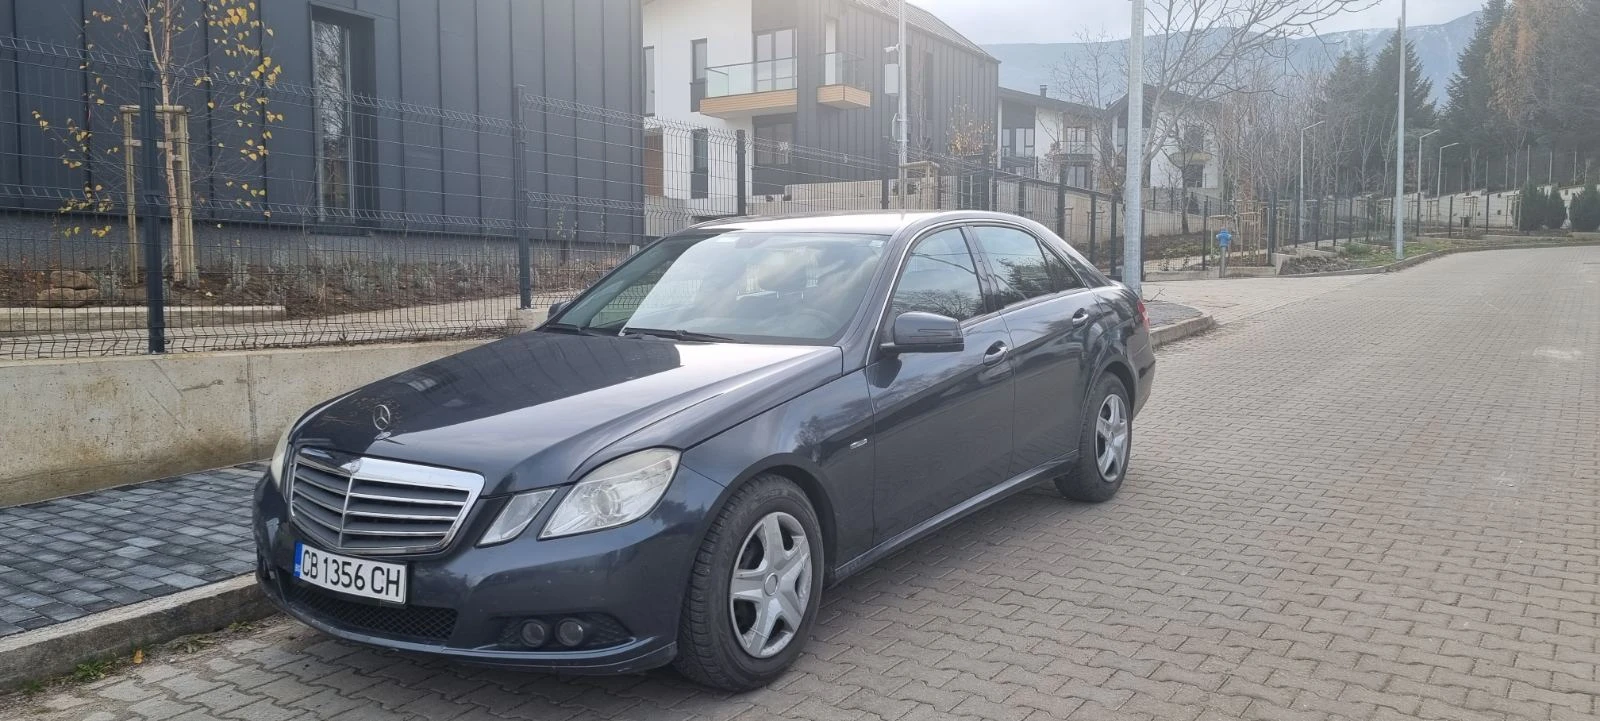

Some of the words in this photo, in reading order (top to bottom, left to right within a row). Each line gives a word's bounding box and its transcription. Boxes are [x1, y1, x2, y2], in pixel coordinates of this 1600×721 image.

[302, 550, 318, 580] CB
[323, 556, 366, 591] 1356
[371, 566, 401, 597] CH
